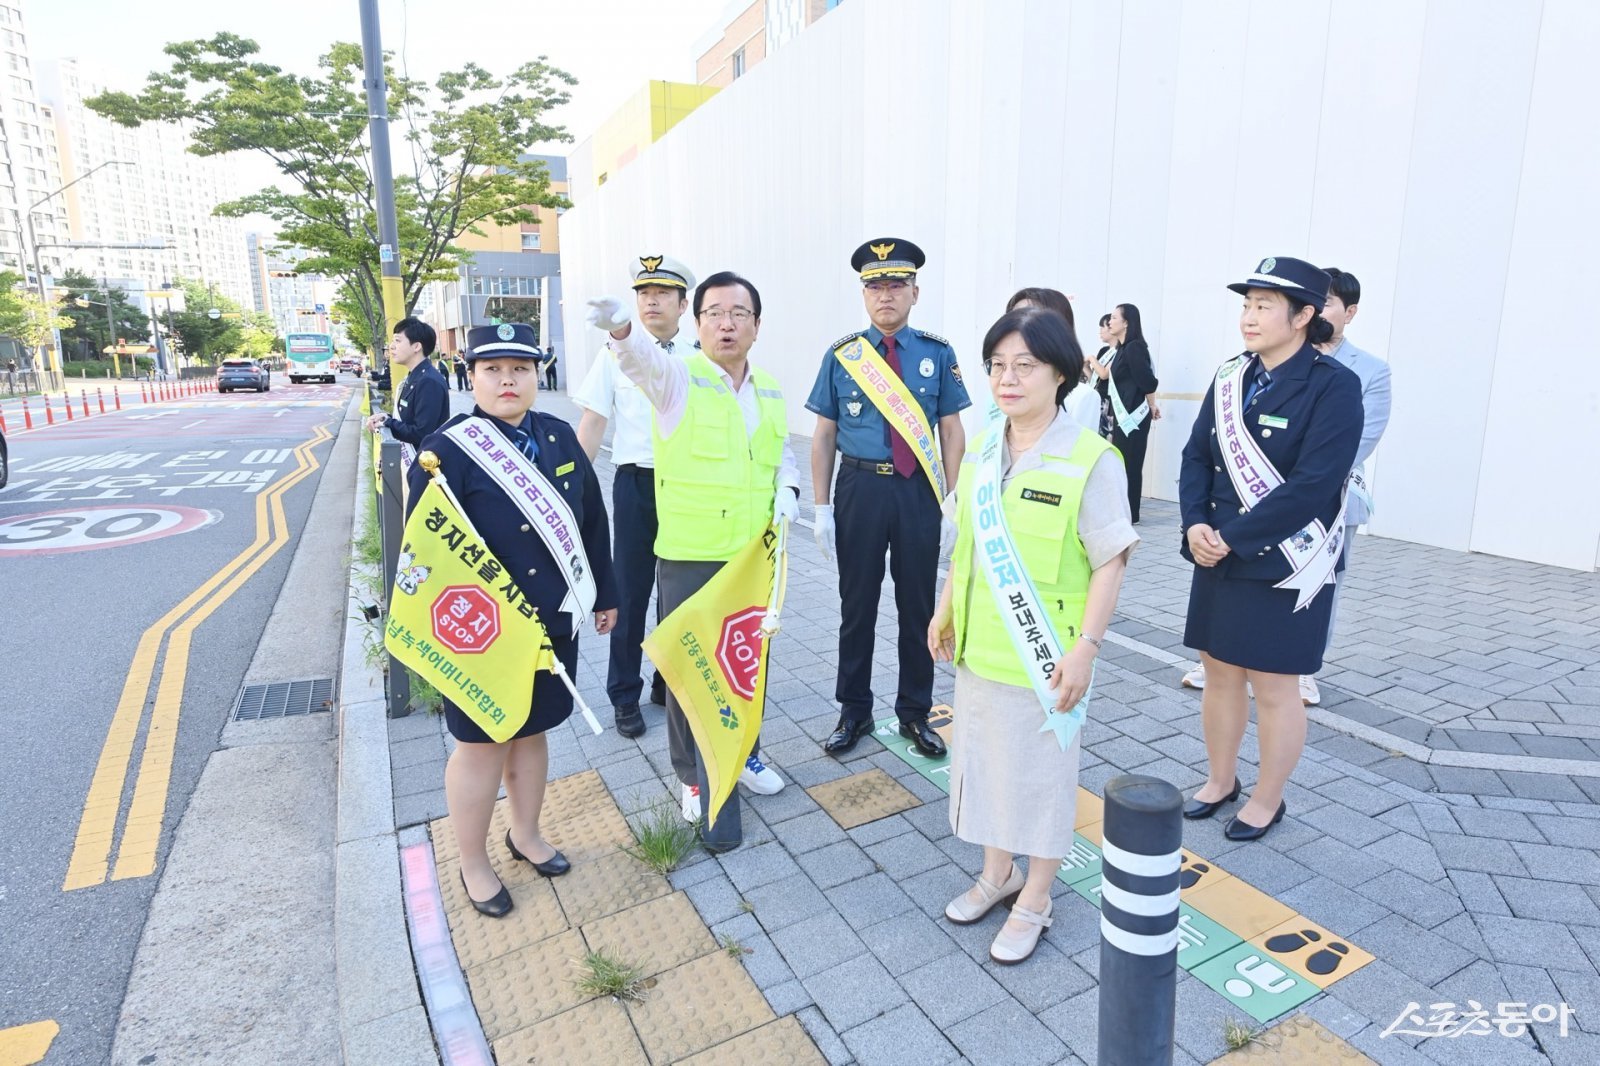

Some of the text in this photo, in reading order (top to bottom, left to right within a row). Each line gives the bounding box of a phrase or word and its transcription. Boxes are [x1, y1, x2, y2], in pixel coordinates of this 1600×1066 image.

[0, 469, 277, 504] 보호구역
[462, 422, 576, 557] 하남녹색어머니연합회
[976, 480, 998, 531] 아이
[0, 512, 163, 544] 30
[425, 506, 503, 585] 정지선을
[984, 535, 1021, 590] 먼저
[439, 613, 475, 646] STOP
[385, 616, 507, 726] 남녹색어머니연합회
